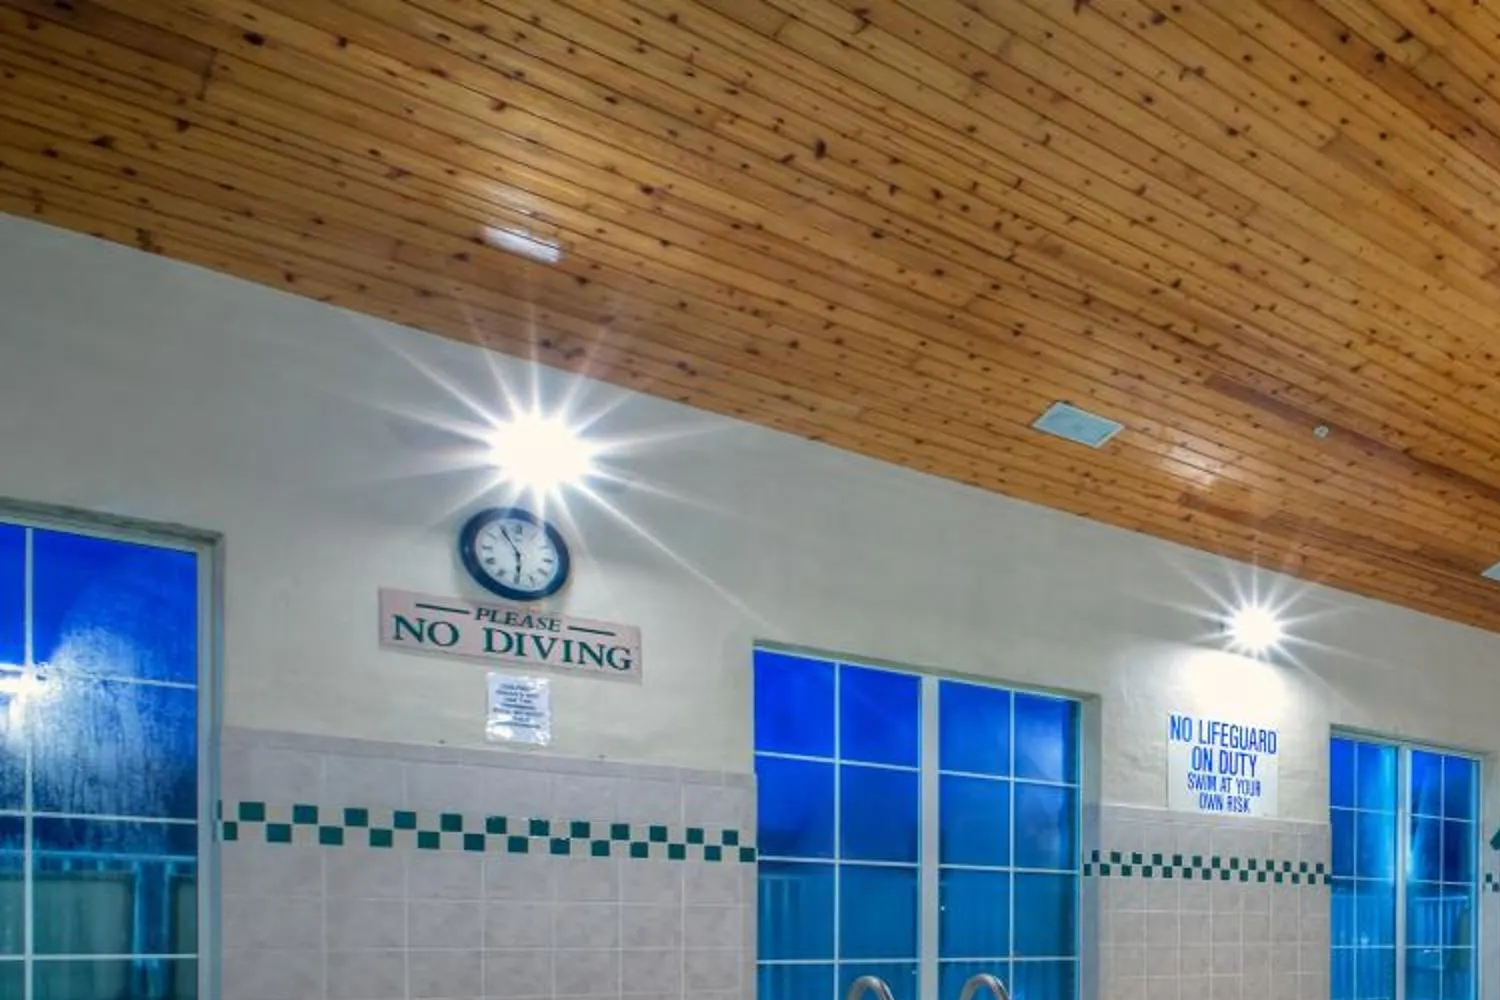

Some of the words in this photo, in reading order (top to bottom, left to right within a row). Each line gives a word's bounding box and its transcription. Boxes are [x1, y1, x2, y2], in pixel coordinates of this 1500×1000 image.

[474, 607, 561, 632] PLEASE
[392, 614, 460, 647] NO
[482, 627, 632, 671] DIVING
[1169, 714, 1193, 742] NO
[1199, 719, 1277, 755] LIFEGUARD
[1191, 746, 1213, 772] ON
[1219, 749, 1257, 778] DUTY
[1187, 772, 1217, 792] SWIM
[1220, 777, 1232, 793] AT
[1236, 779, 1262, 797] YOUR
[1199, 792, 1223, 811] OWN
[1227, 795, 1251, 813] RISK
